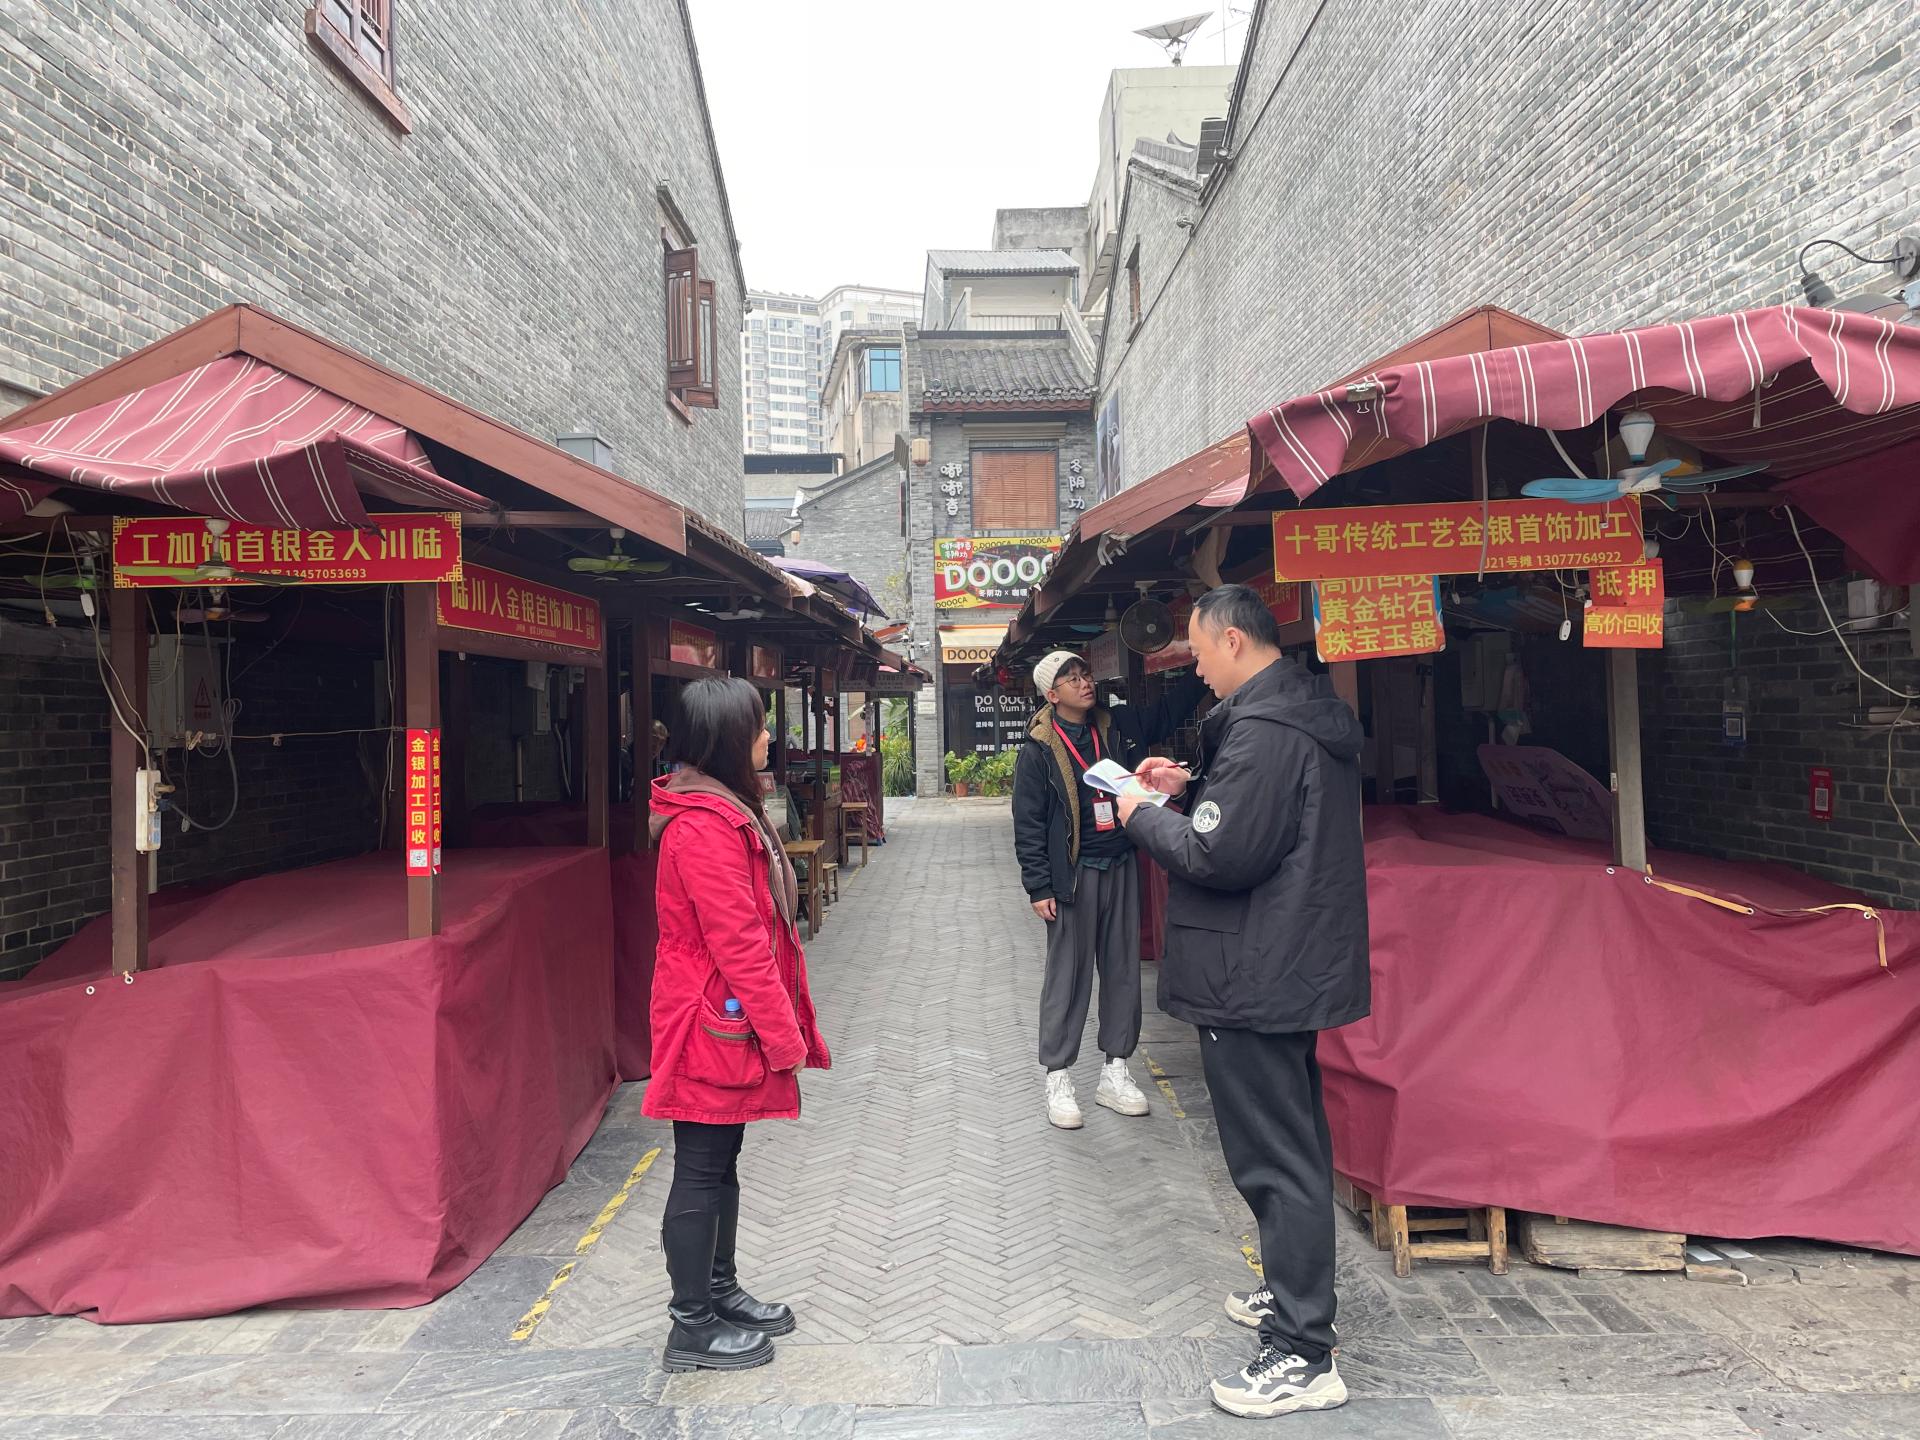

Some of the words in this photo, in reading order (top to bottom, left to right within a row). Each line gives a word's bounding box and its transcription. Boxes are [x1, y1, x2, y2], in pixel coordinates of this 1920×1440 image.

[1068, 458, 1085, 510] 冬阴功
[1285, 510, 1632, 554] 十哥传统工艺金银首饰加工
[286, 568, 367, 579] 13457053693
[1537, 551, 1622, 566] 13077764922
[1597, 568, 1657, 596] 抵押
[1322, 590, 1433, 627] 黄金钻石
[1583, 612, 1662, 637] 高价回收
[1323, 620, 1438, 657] 珠宝玉器
[410, 737, 426, 844] 金银加工回收
